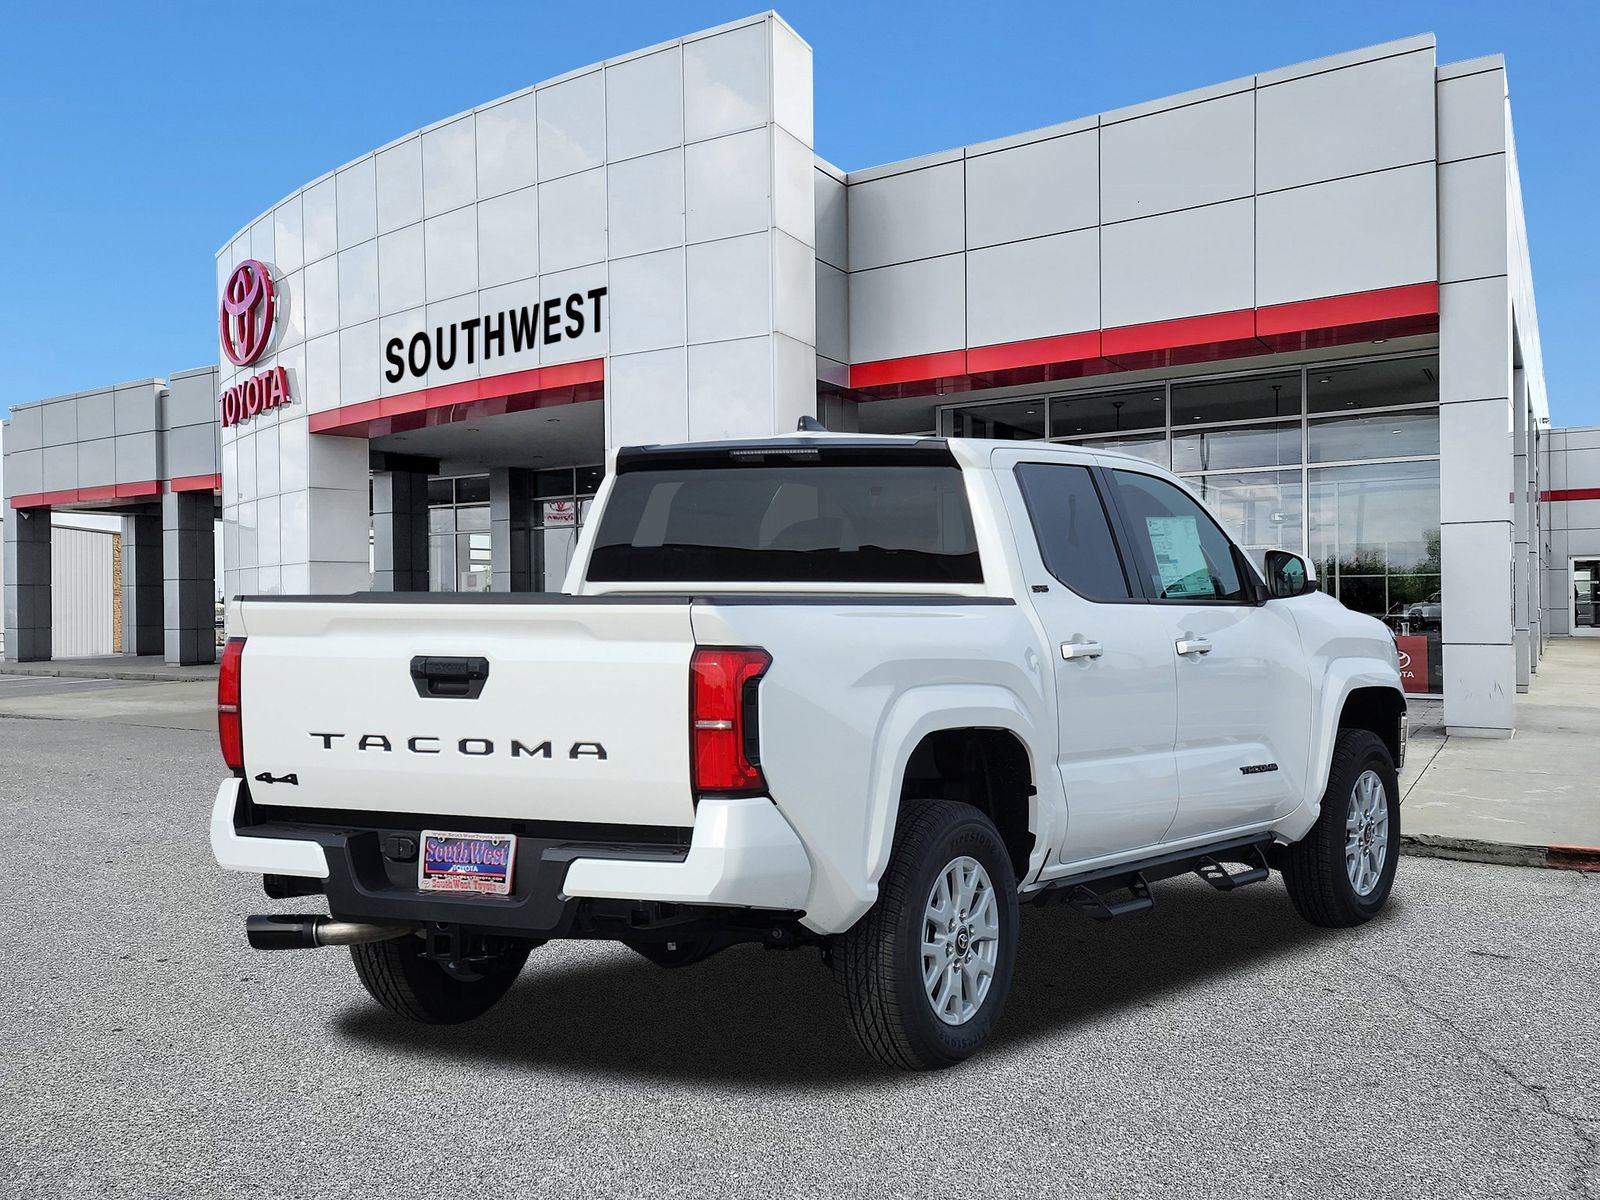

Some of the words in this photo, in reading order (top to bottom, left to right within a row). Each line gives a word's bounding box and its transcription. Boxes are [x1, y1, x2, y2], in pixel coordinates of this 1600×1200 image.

[385, 286, 608, 384] SOUTHWEST
[218, 366, 292, 428] TOYOTA
[307, 731, 608, 760] TACOMA
[1239, 762, 1279, 775] TACOMA
[453, 864, 478, 872] TOYOTA
